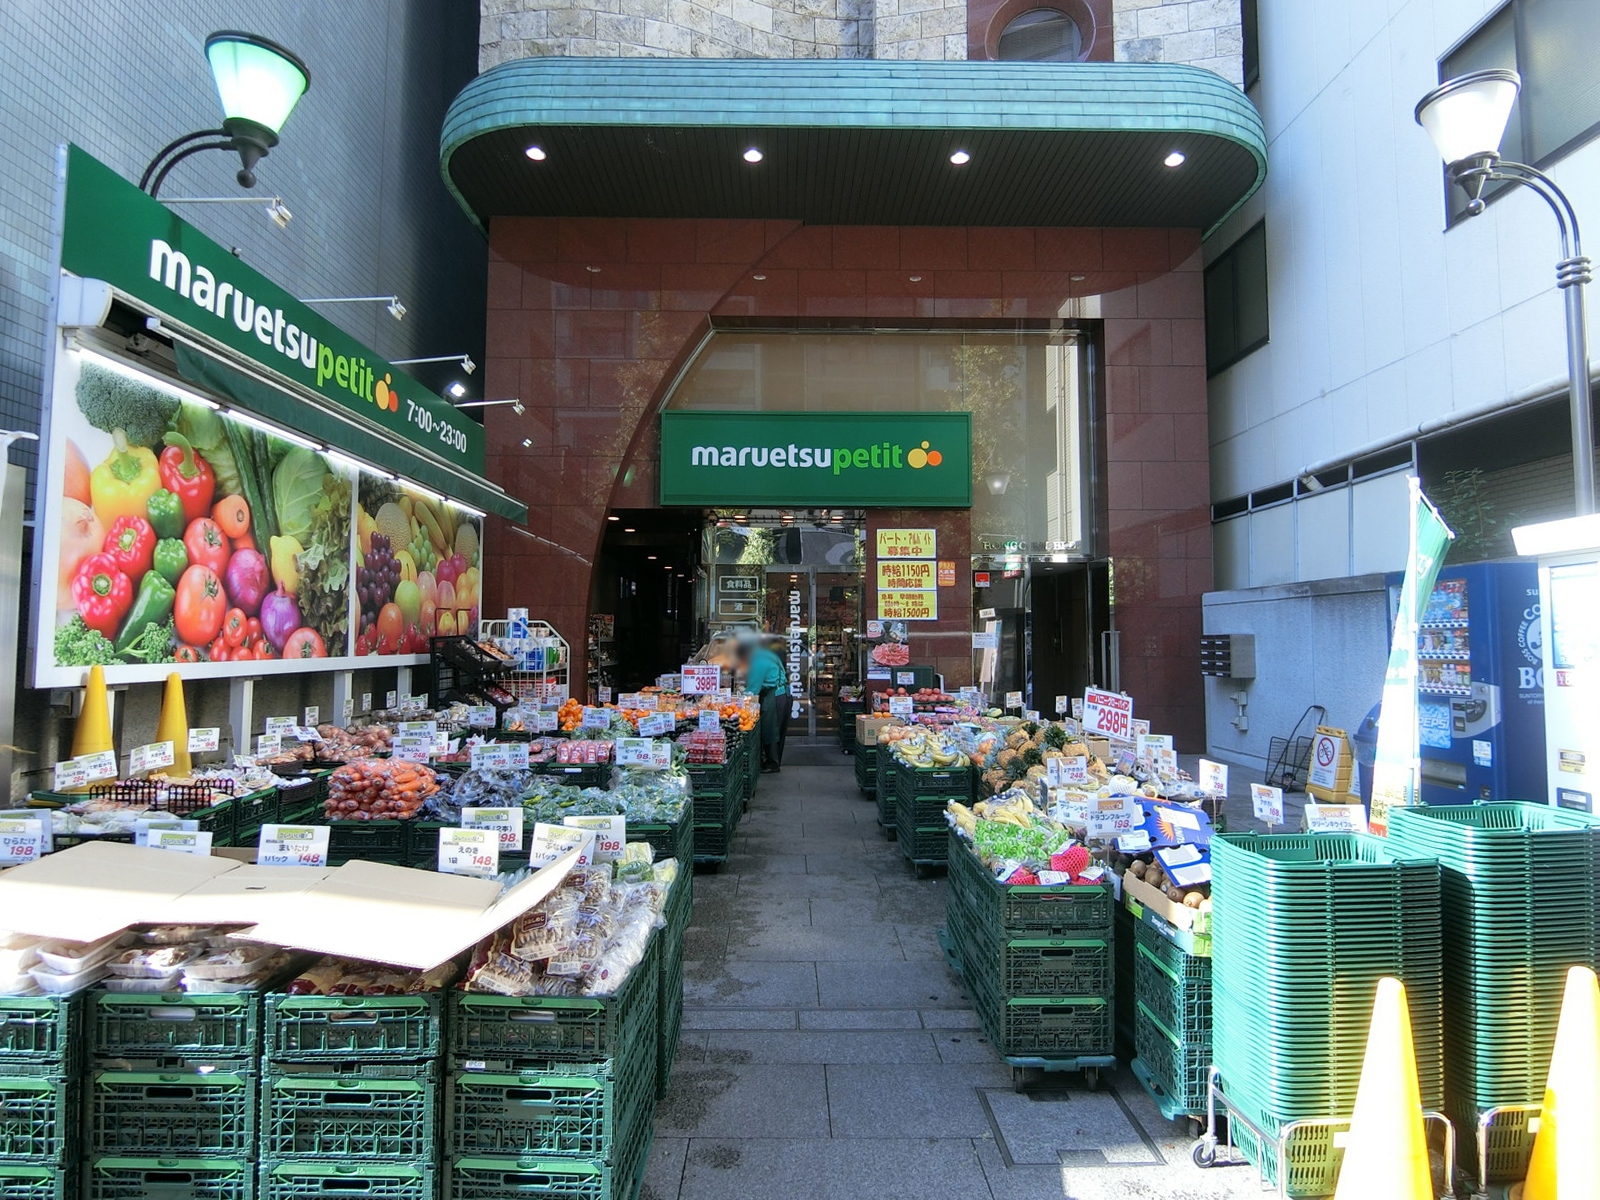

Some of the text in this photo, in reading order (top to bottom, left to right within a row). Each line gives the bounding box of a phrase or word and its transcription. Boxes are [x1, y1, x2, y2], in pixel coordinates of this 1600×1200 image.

[149, 239, 374, 403] maruetsupetit
[691, 442, 903, 475] maruetsupetit
[887, 546, 922, 556] 募集中
[882, 564, 930, 577] 時給1150円
[726, 579, 752, 589] 食料品
[734, 602, 743, 611] 酒
[884, 607, 930, 618] 時給1500円
[1517, 620, 1529, 648] COFFEE
[786, 590, 804, 699] maruetsupetit
[695, 676, 717, 691] 398円
[1097, 708, 1128, 737] 298円
[1090, 812, 1132, 821] ドラゴンフルーツ
[3, 837, 37, 846] ひらたけ
[278, 844, 310, 853] まいたけ
[458, 846, 479, 854] えのき
